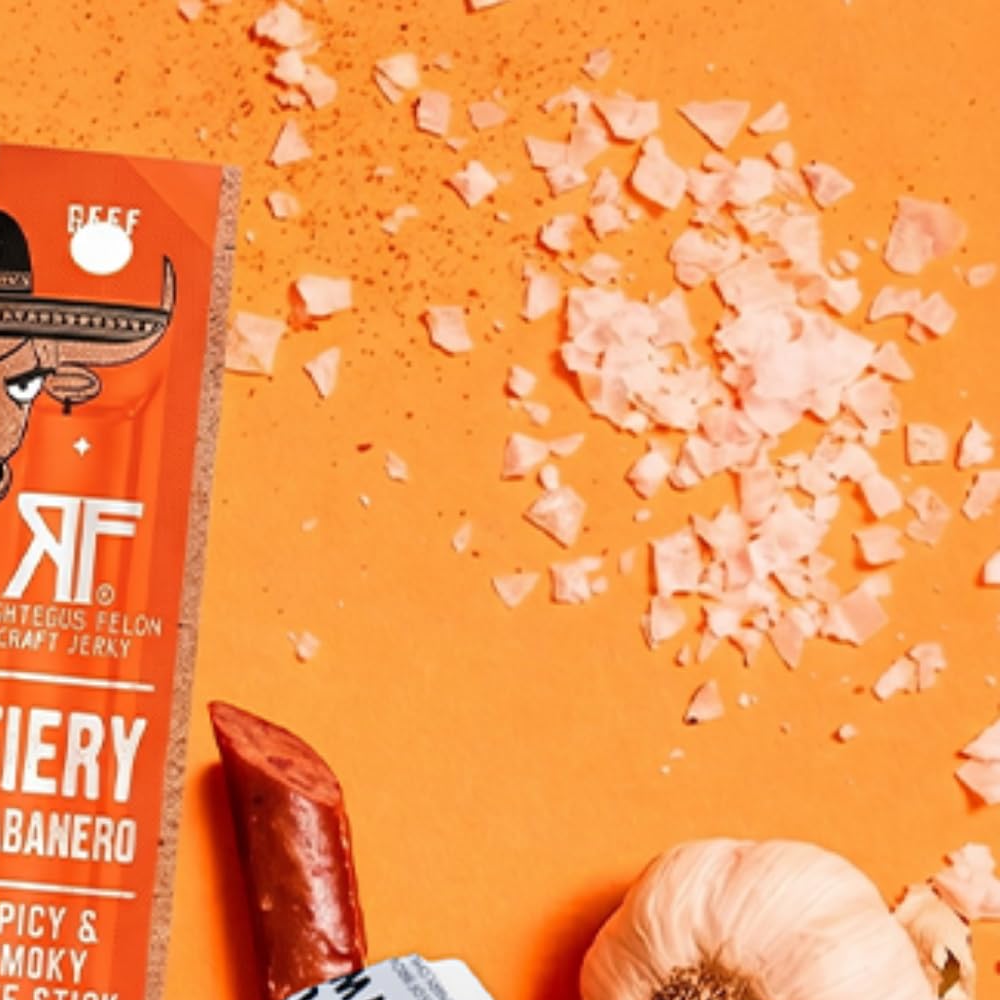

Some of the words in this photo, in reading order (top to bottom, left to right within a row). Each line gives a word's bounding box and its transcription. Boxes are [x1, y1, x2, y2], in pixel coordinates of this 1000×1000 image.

[96, 611, 163, 637] FELON
[67, 635, 132, 658] JERKY
[78, 910, 98, 943] &
